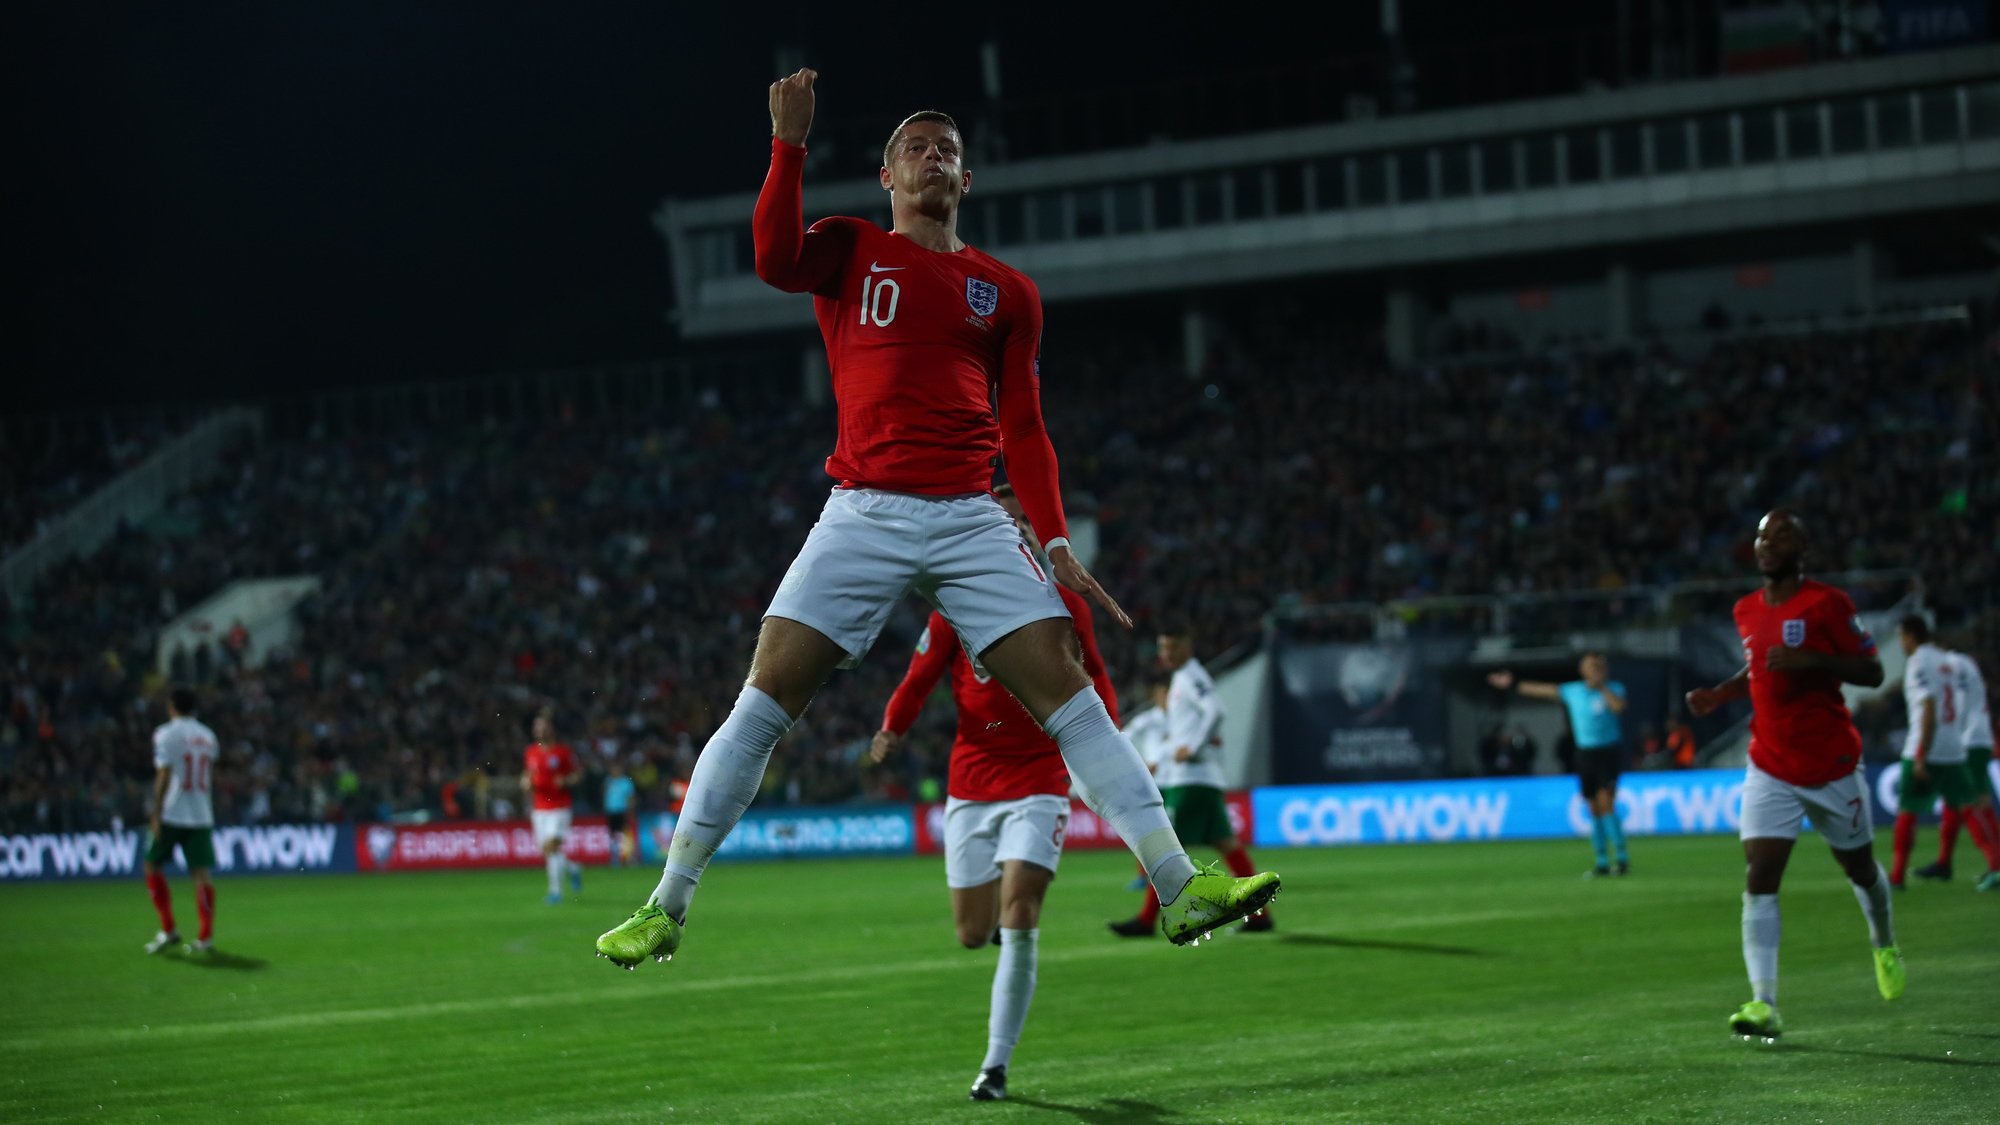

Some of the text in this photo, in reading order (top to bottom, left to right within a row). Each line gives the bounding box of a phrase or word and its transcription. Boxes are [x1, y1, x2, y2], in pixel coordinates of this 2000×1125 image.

[860, 275, 900, 327] 10
[1279, 790, 1509, 845] carwow
[1848, 798, 1861, 828] 7
